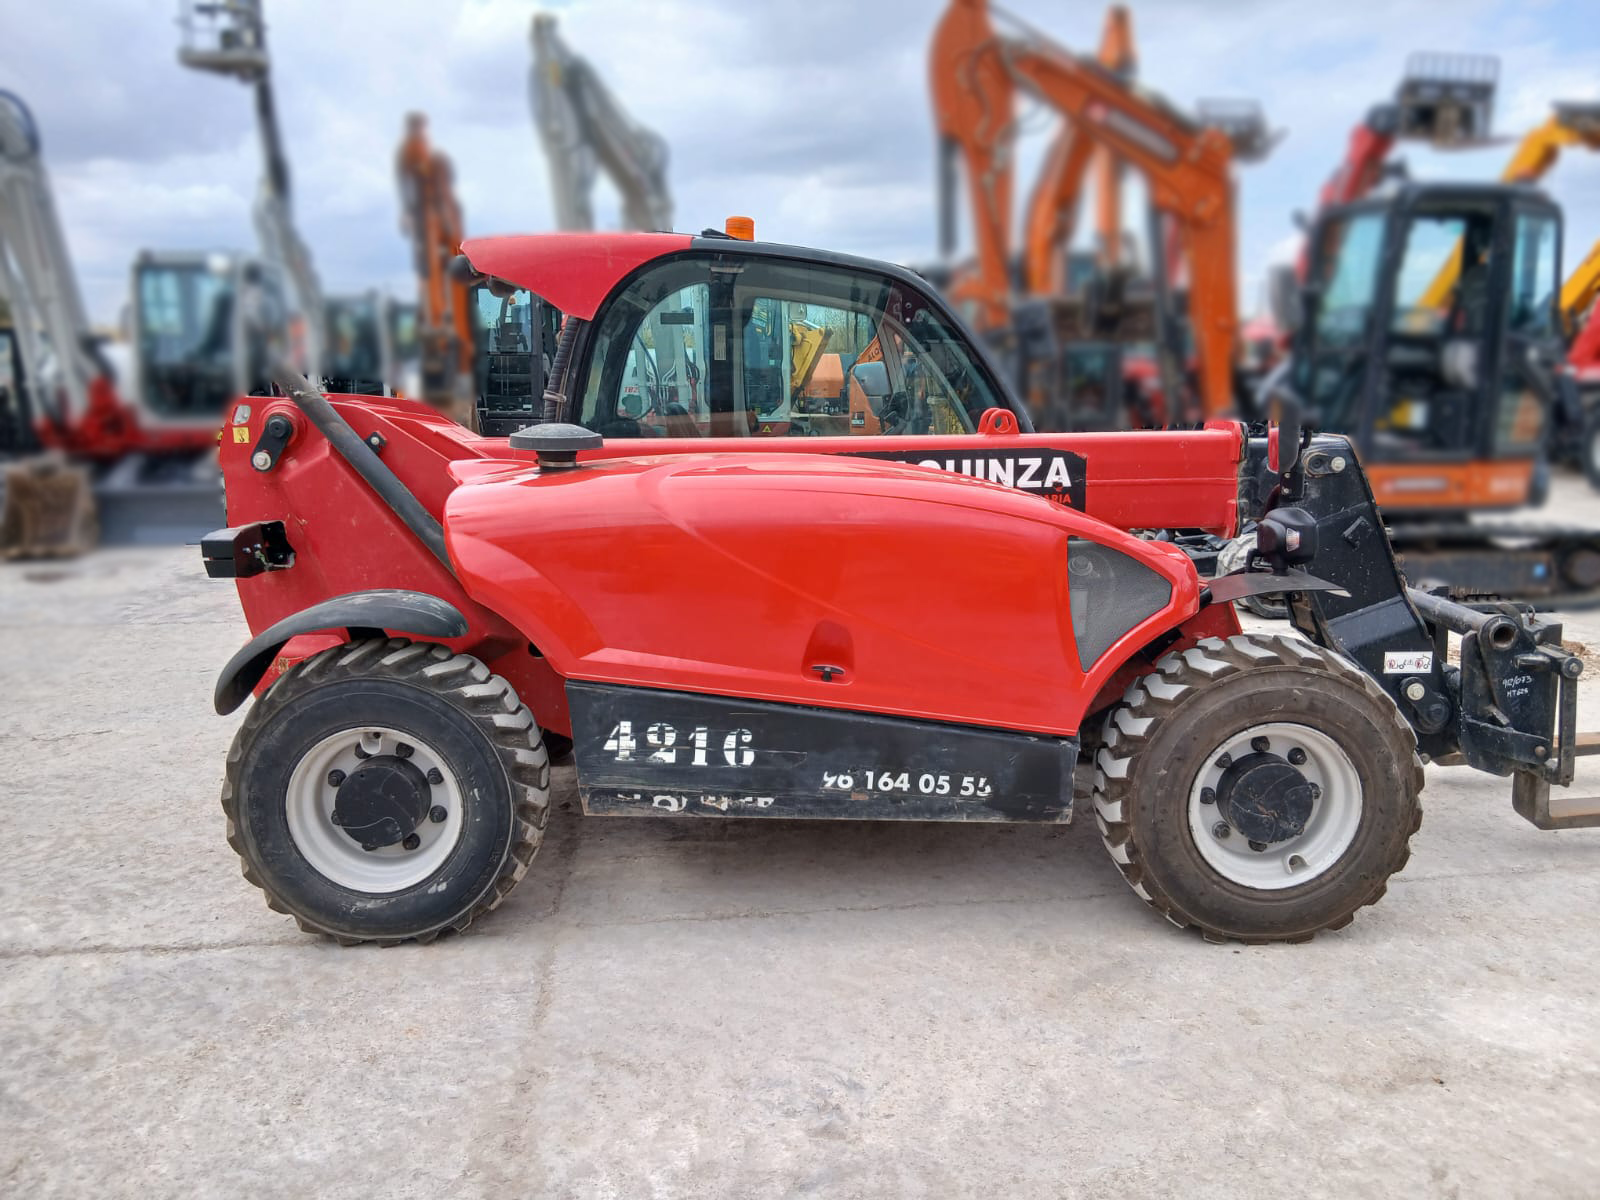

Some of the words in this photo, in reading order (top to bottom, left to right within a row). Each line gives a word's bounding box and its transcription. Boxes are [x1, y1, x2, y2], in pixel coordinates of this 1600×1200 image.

[865, 770, 911, 792] 164
[918, 773, 950, 795] 05
[959, 776, 992, 797] 55
